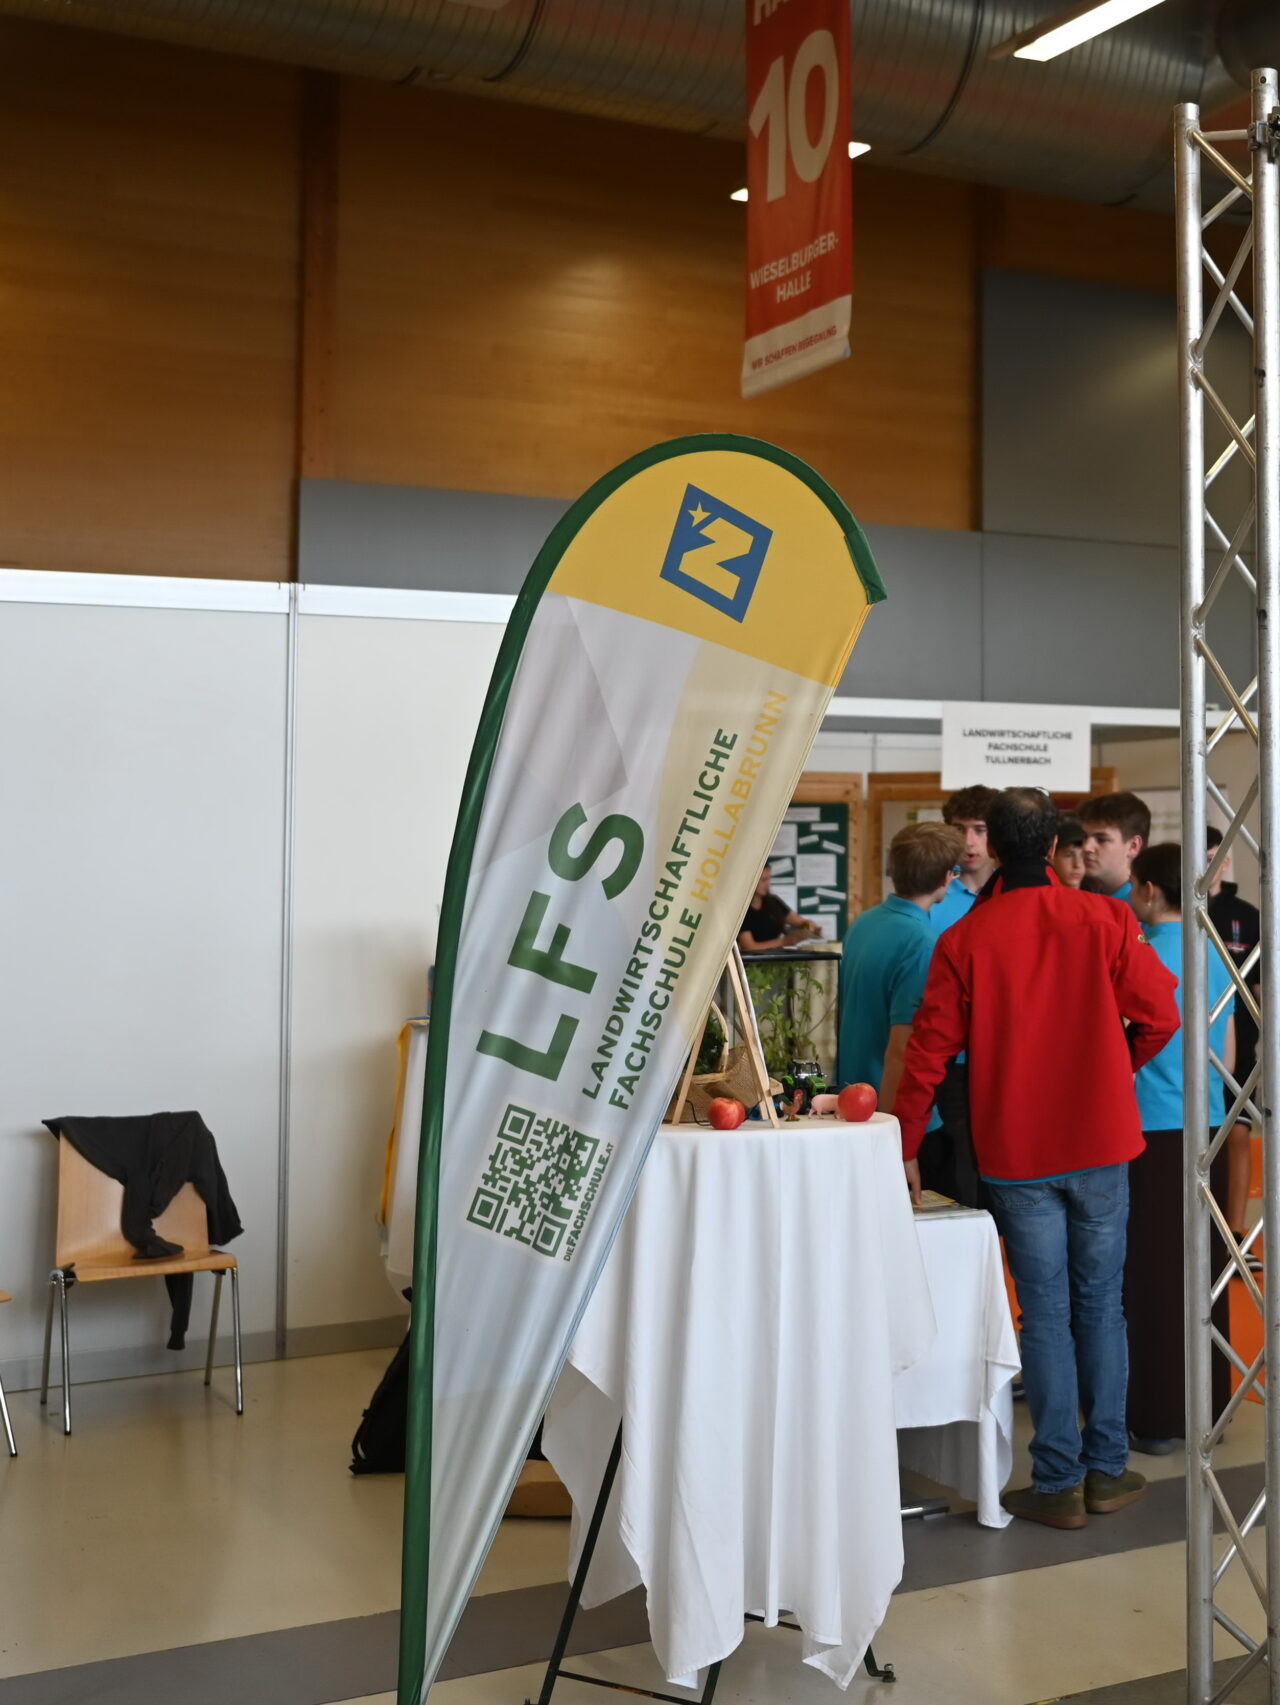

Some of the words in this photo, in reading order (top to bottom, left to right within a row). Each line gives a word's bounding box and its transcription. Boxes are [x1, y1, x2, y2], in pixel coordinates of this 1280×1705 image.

[749, 29, 840, 202] 10
[776, 270, 812, 304] HALLE
[962, 728, 1072, 740] LANDWIRTSCHAFTLICHE
[985, 755, 1052, 765] TULLNERBACH
[988, 742, 1048, 752] FACHSCHULE
[476, 801, 645, 1082] LFS
[581, 727, 738, 1100] LANDWIRTSCHAFTLICHE
[608, 907, 703, 1111] FACHSCHULE
[689, 690, 789, 902] HOLLABRUNN
